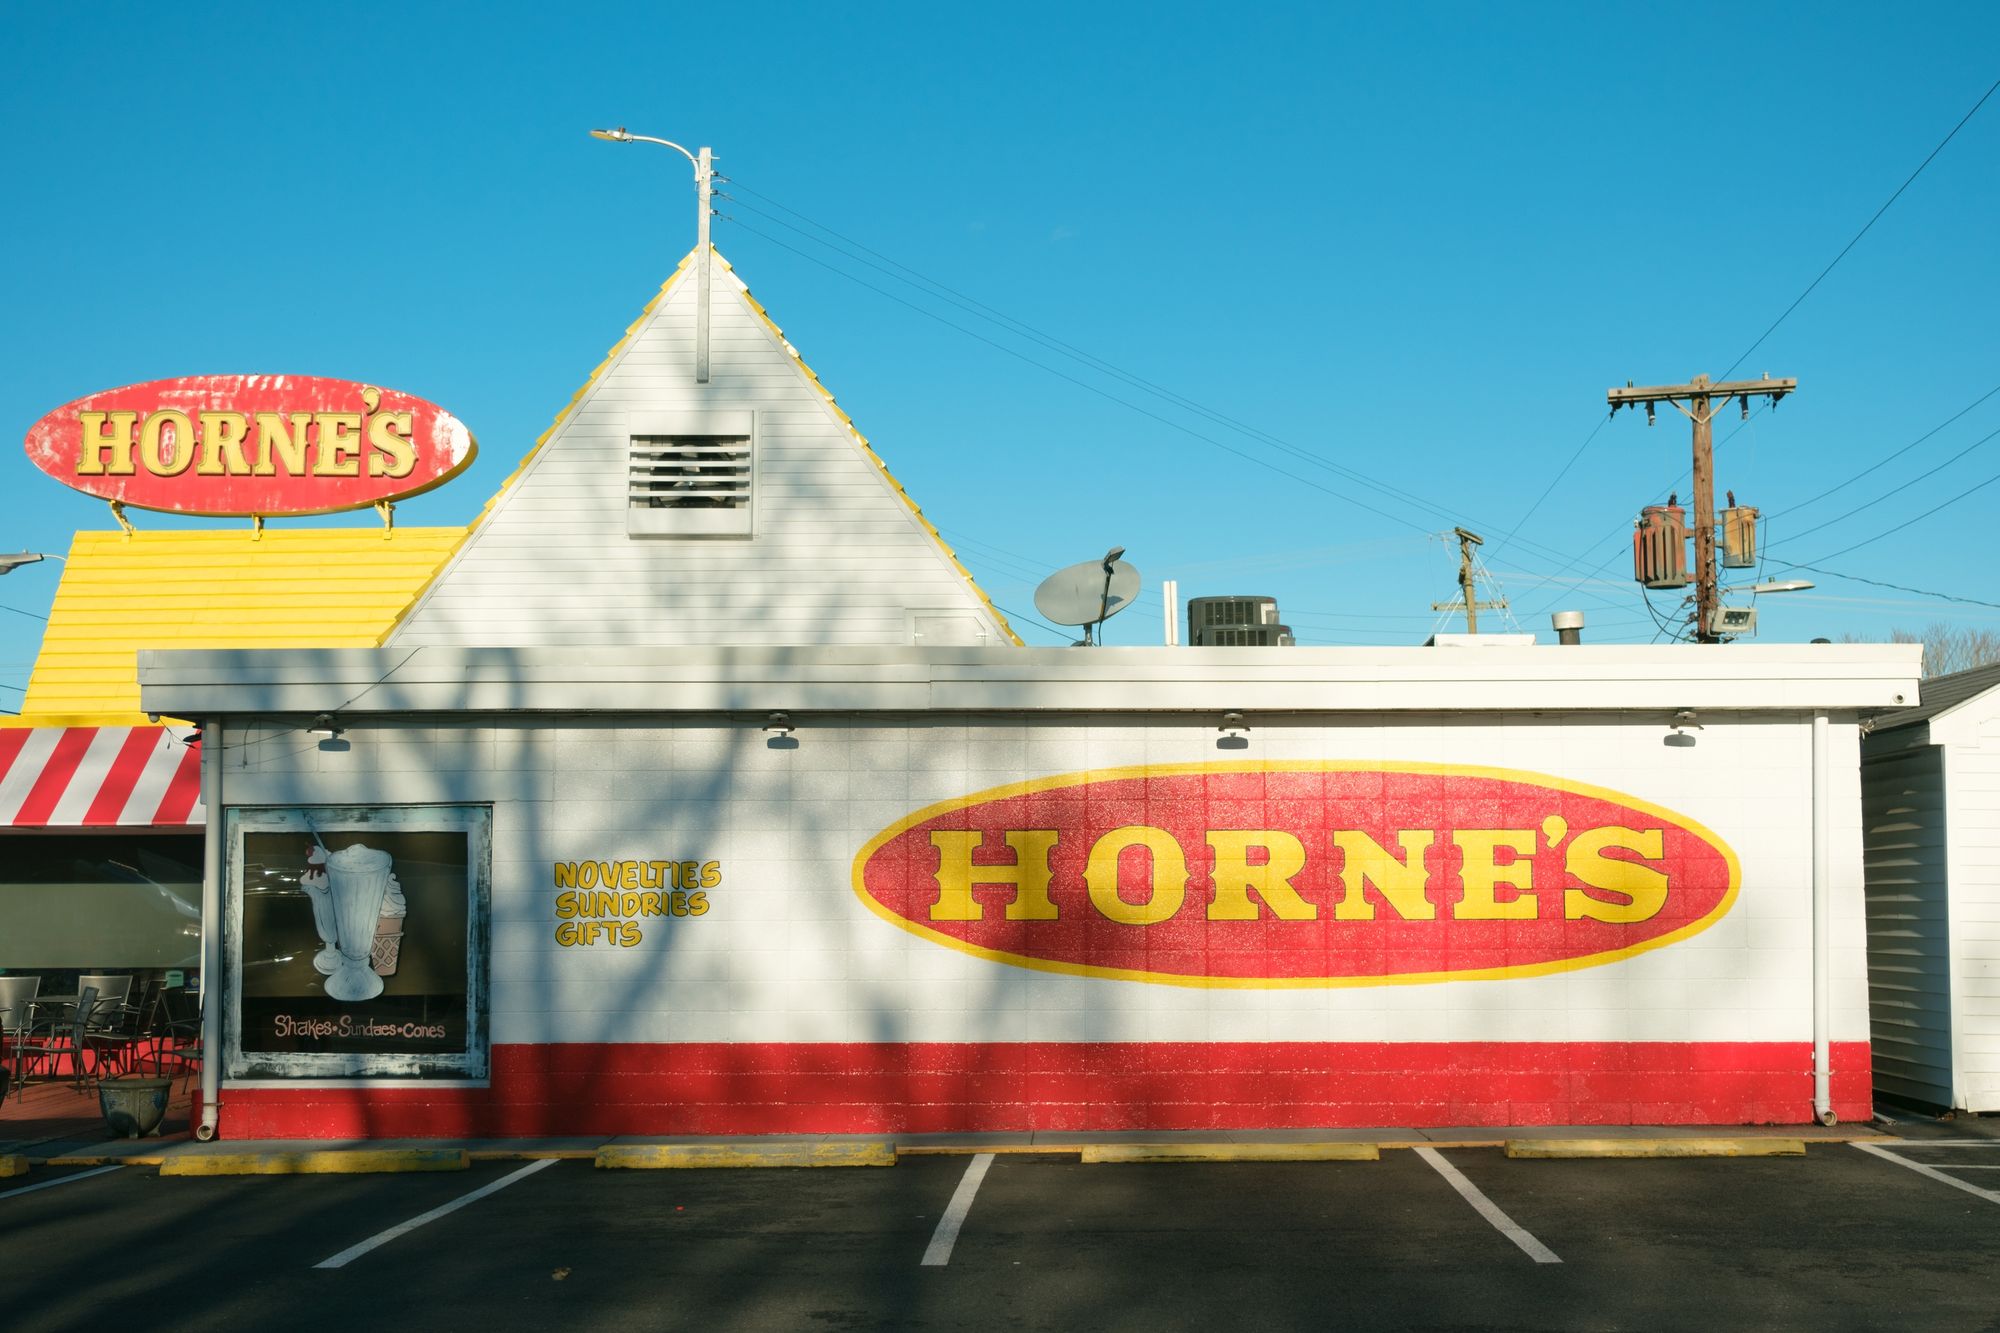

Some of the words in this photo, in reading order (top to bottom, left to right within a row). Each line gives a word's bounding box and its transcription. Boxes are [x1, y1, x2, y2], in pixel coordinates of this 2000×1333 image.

[75, 387, 419, 478] HORNE'S
[554, 860, 722, 889] NOVELTIES
[928, 814, 1671, 926] HORNE'S
[555, 891, 710, 919] SUNDRIES
[555, 921, 643, 947] GIFTS
[274, 1014, 333, 1040] Shakes
[338, 1014, 397, 1038] Sundaes
[402, 1022, 446, 1039] Cones
